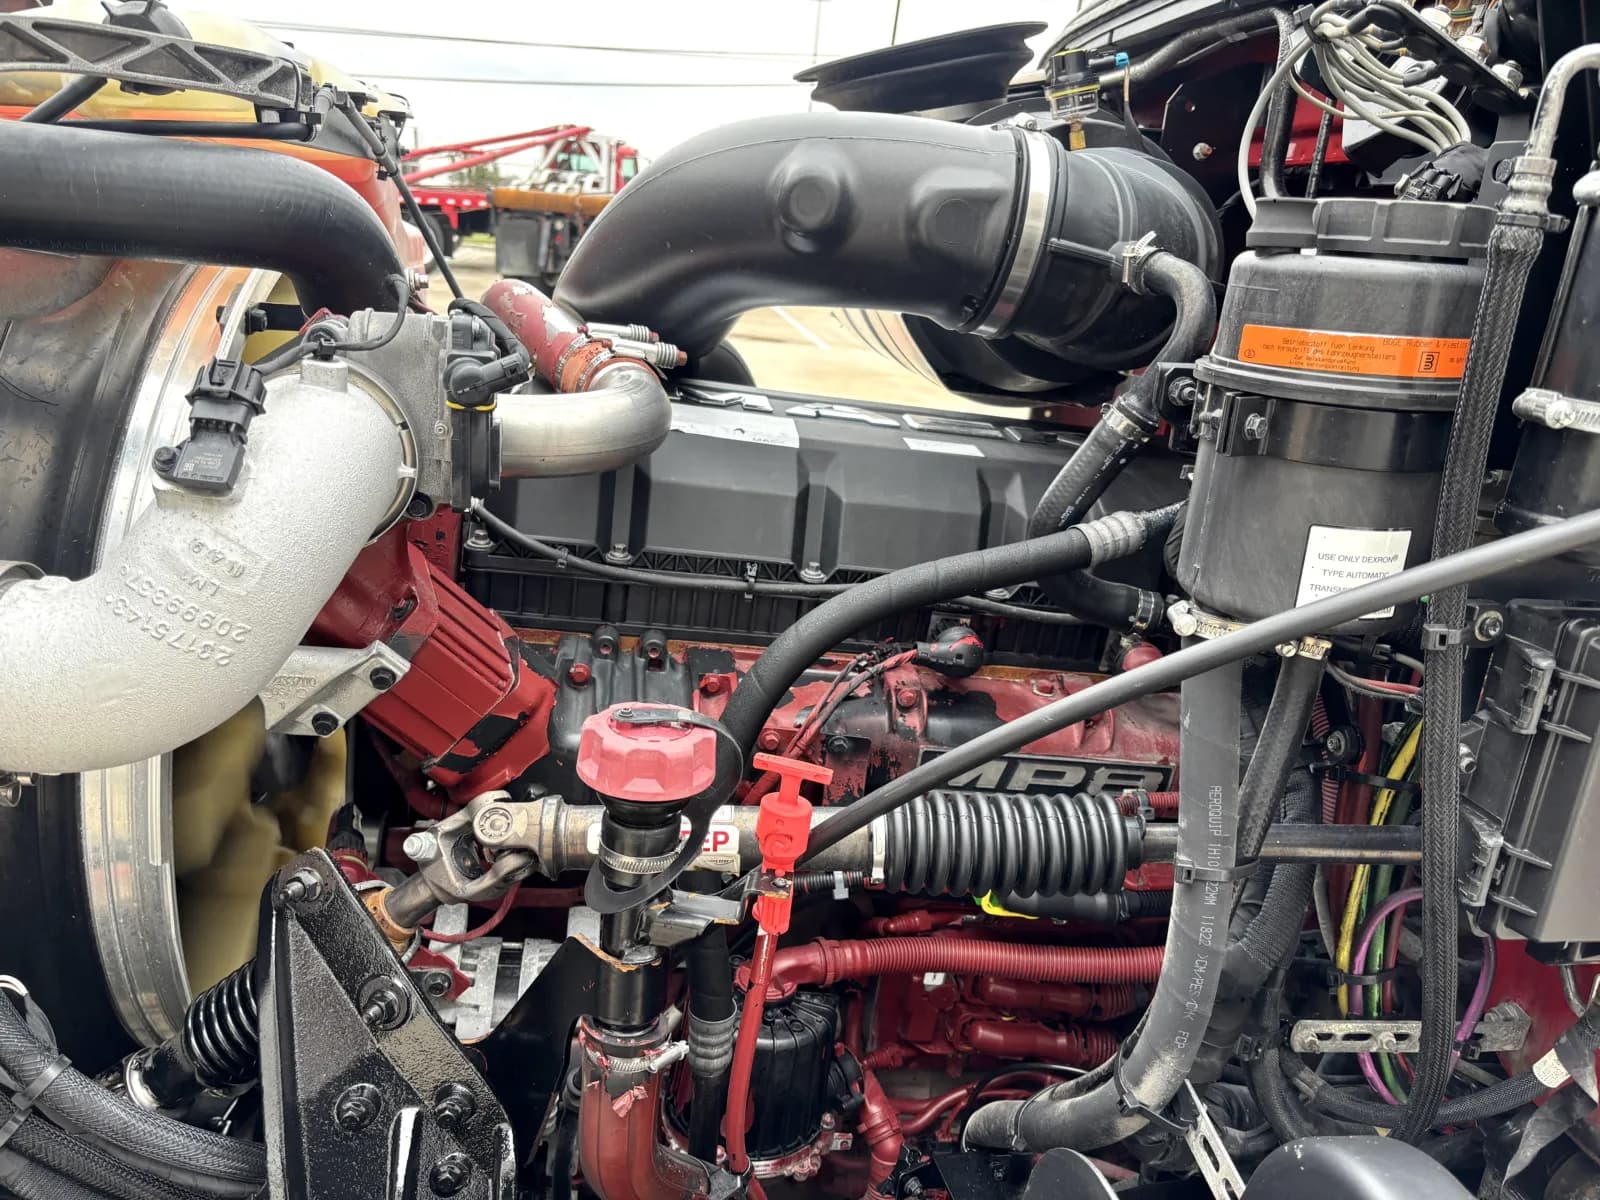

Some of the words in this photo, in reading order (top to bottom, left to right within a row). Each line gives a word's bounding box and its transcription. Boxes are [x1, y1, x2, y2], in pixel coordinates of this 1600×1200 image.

[1318, 552, 1336, 561] USE
[1338, 554, 1361, 563] ONLY
[1322, 568, 1344, 578] TYPE
[1346, 570, 1390, 580] AUTOMATIC
[1208, 785, 1222, 837] AEROQUIP
[1197, 915, 1213, 947] 11822
